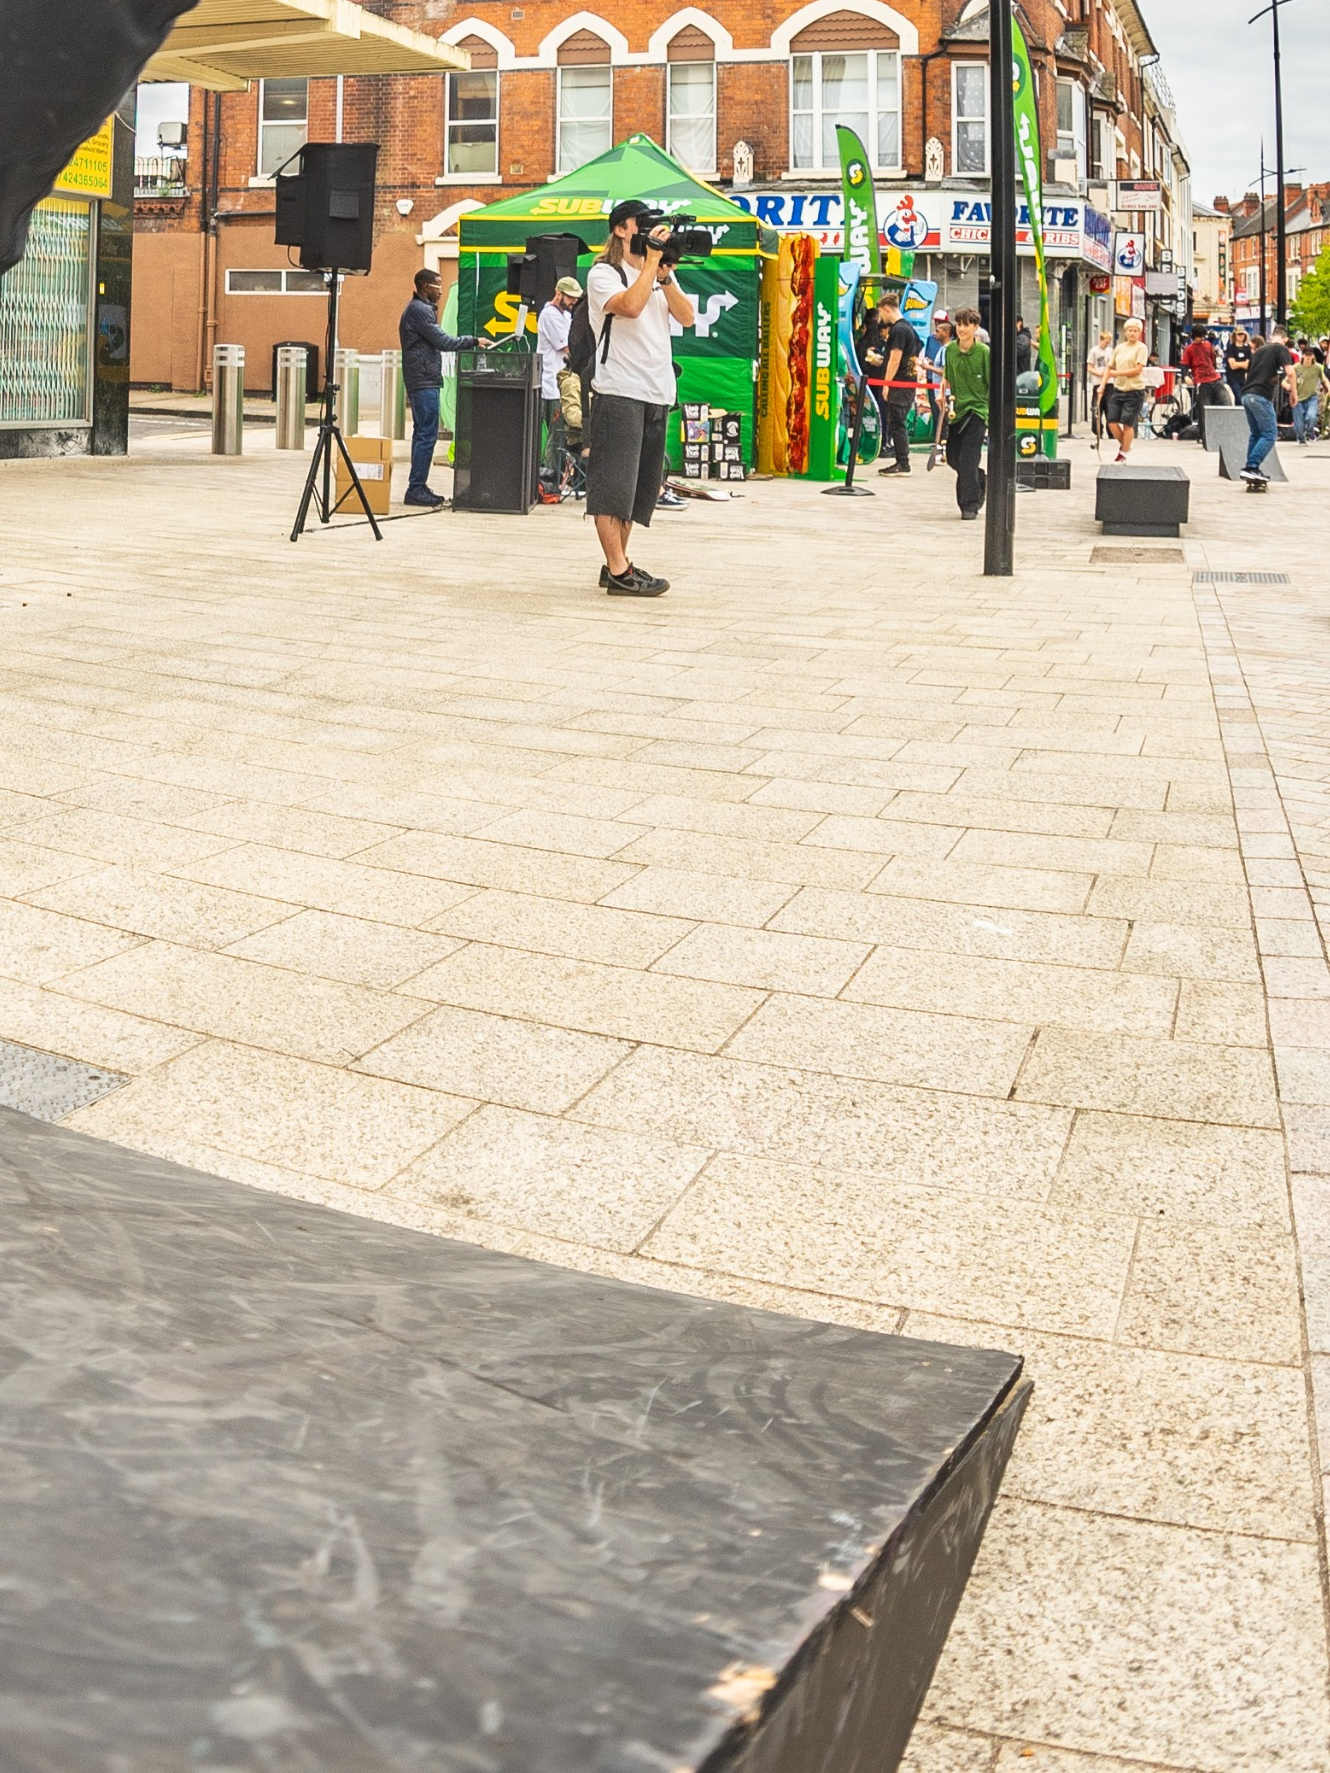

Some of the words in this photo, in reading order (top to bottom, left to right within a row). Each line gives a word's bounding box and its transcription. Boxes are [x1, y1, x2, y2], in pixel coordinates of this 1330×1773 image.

[951, 201, 1079, 227] FARTE
[950, 228, 990, 240] CHIC
[1043, 233, 1080, 245] RIBS
[1177, 267, 1187, 313] BEDS
[816, 301, 832, 421] SUBWAY
